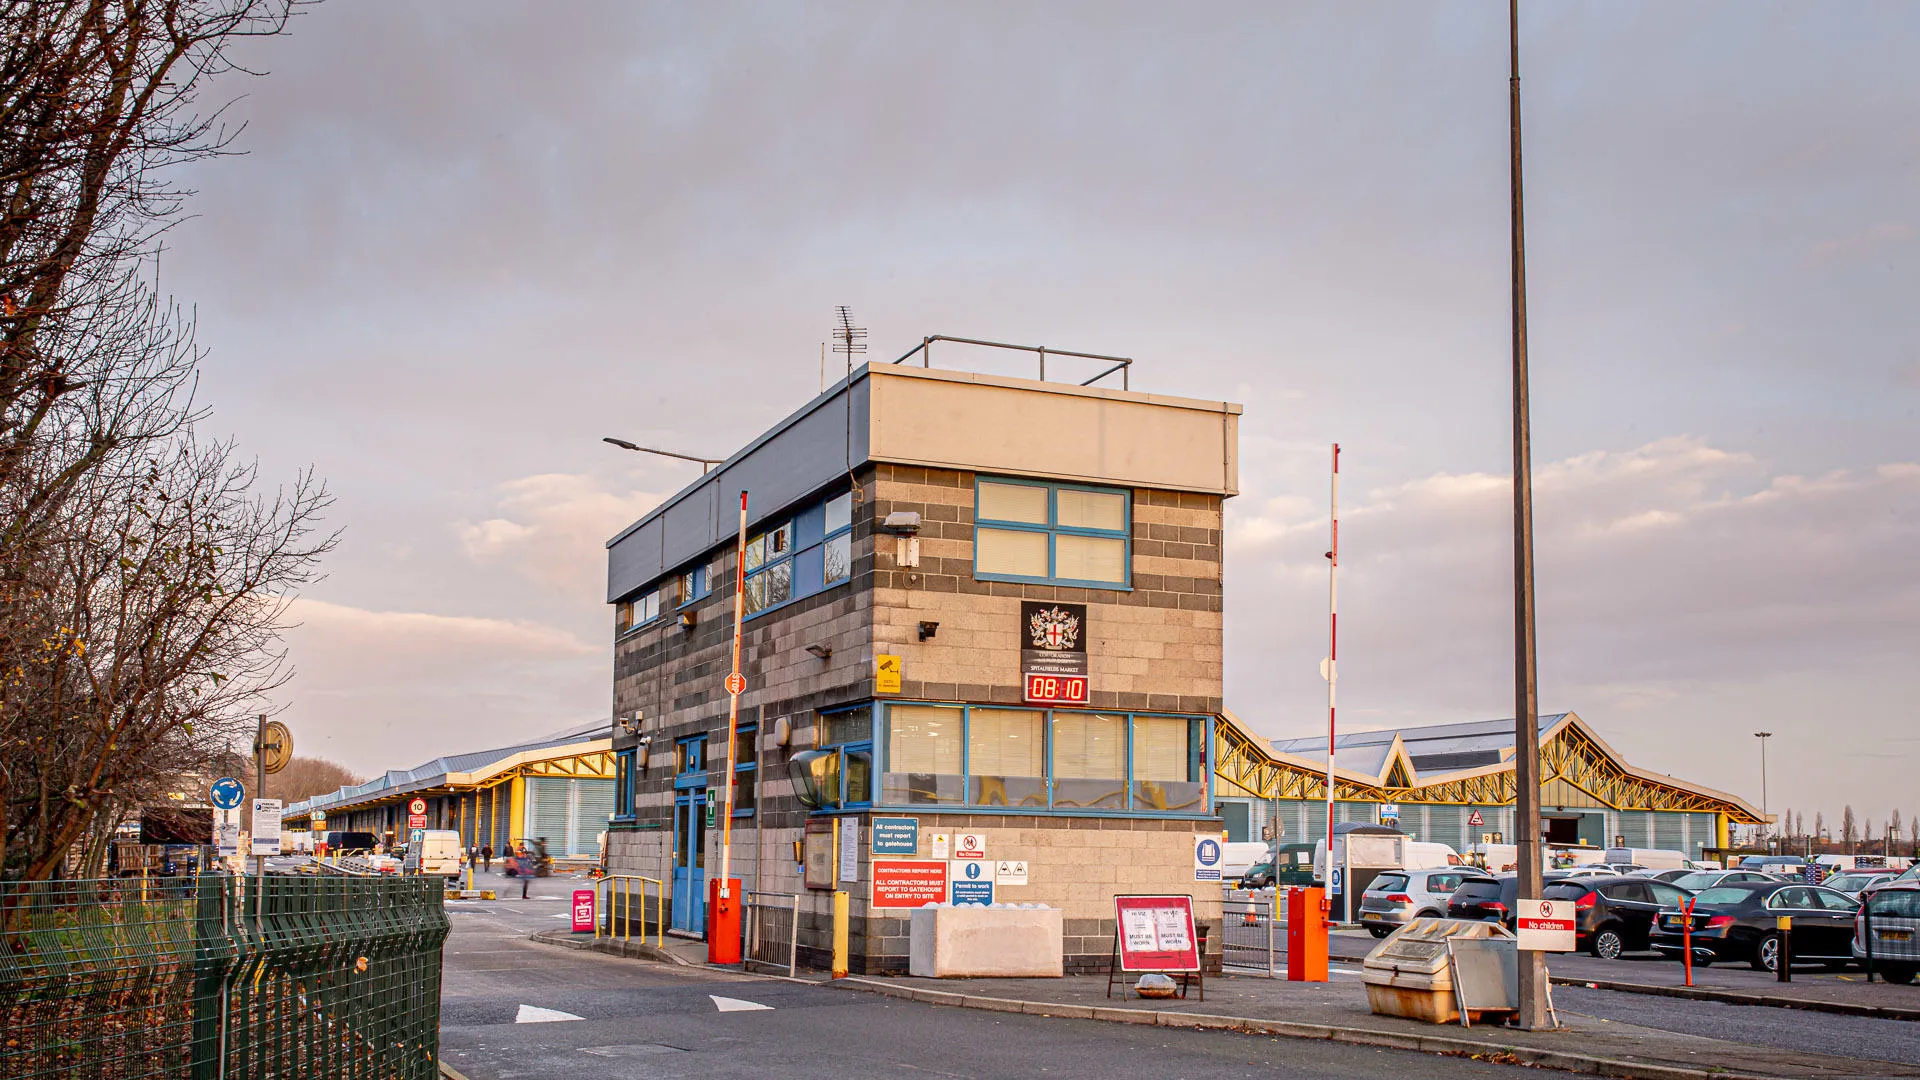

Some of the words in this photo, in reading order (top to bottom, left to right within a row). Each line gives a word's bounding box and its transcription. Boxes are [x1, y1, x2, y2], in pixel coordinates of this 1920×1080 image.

[731, 674, 740, 693] STOP
[1032, 677, 1082, 699] 08:10
[413, 803, 423, 811] 10
[1528, 921, 1538, 929] No
[1539, 922, 1564, 930] children
